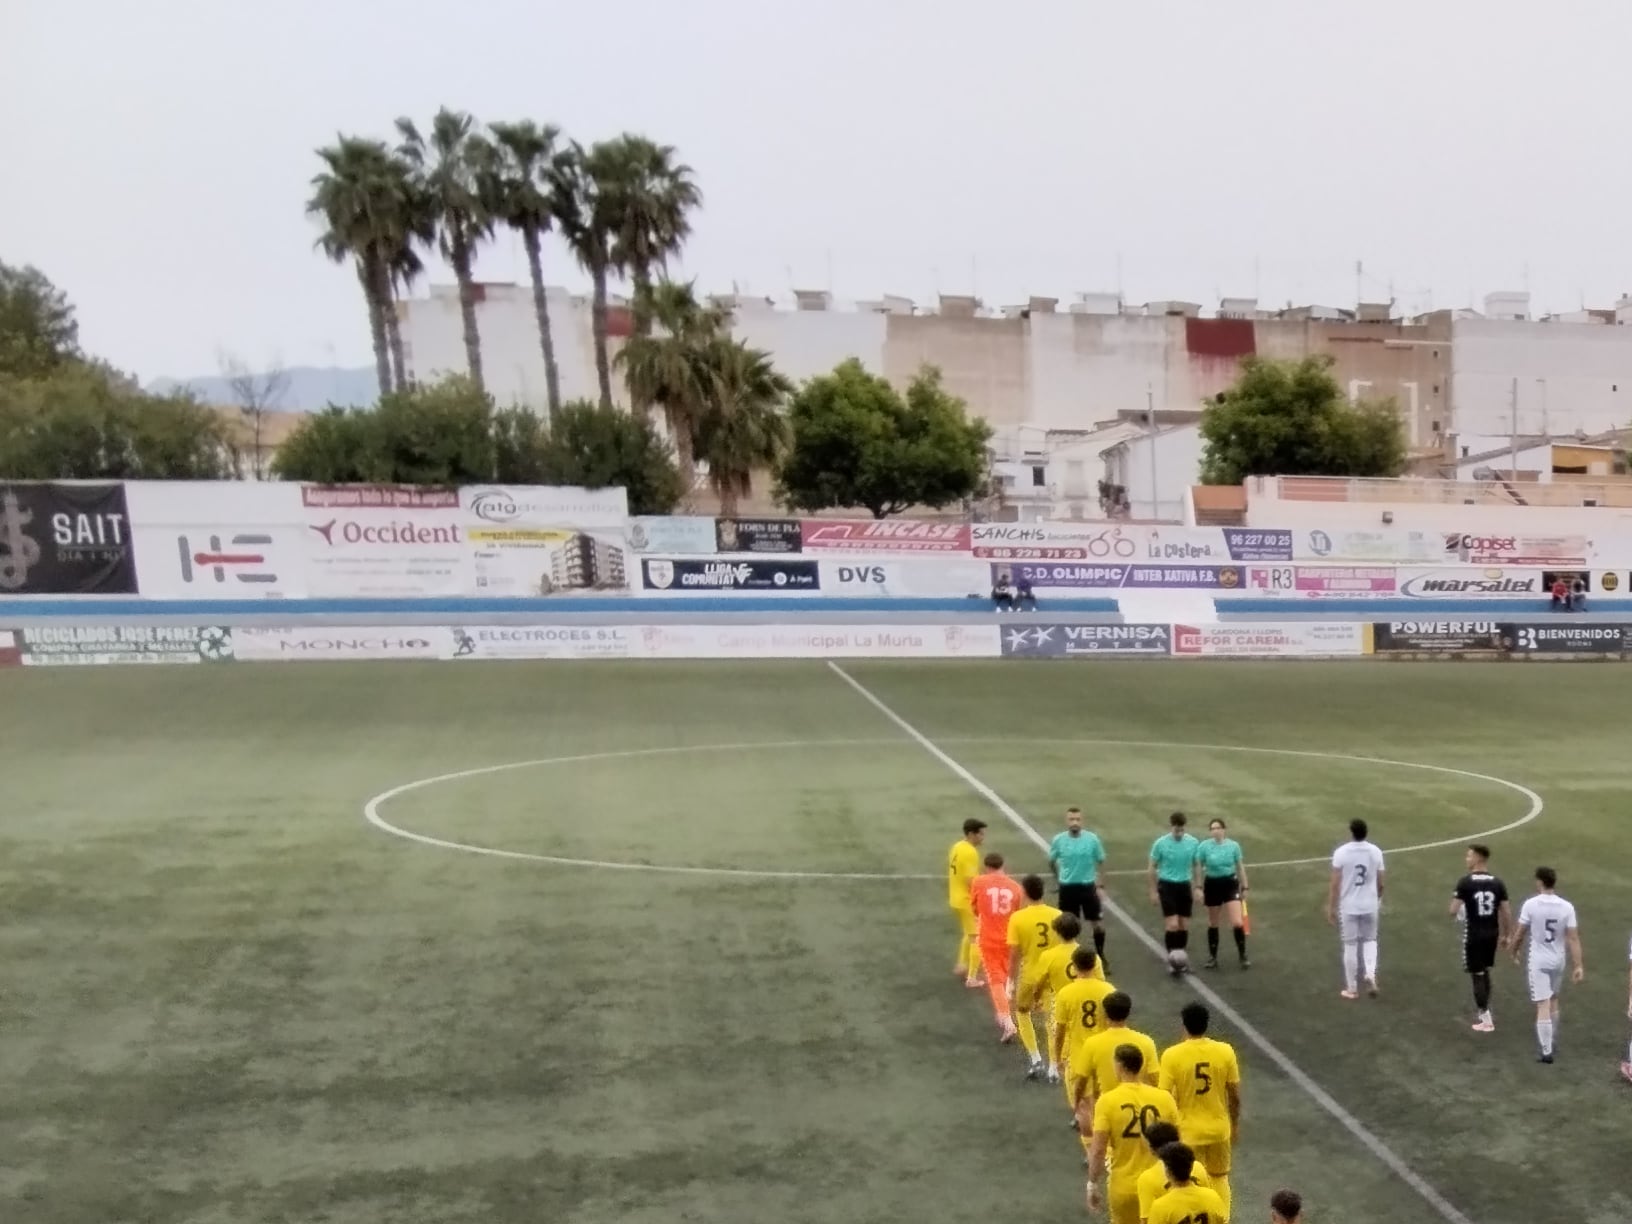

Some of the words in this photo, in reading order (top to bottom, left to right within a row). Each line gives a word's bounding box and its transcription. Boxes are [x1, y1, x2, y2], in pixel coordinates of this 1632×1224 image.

[52, 512, 123, 545] SAIT
[343, 521, 461, 544] Occident
[972, 527, 1046, 541] SANCHIS
[1231, 535, 1243, 545] 96
[1245, 535, 1263, 545] 227
[1264, 535, 1276, 545] 00
[1278, 535, 1290, 545] 25
[1462, 535, 1517, 554] Copiset
[1148, 544, 1161, 558] La
[1164, 543, 1212, 559] Costera
[838, 566, 887, 583] DVS
[1053, 567, 1122, 580] OLIMPIC
[1133, 569, 1163, 582] INTER
[1272, 569, 1293, 590] R3
[1064, 626, 1168, 639] VERNISA
[1389, 621, 1502, 634] POWERFUL
[1537, 629, 1621, 640] BIENVENIDOS
[717, 634, 767, 650] Camp
[770, 633, 848, 648] Municipal
[853, 634, 872, 647] La
[877, 633, 923, 648] Murta
[1066, 642, 1166, 650] HOTEL
[1184, 635, 1235, 646] REFOR
[1236, 636, 1290, 646] CAREMI
[1354, 864, 1368, 887] 3
[986, 886, 1014, 915] 13
[1473, 890, 1496, 917] 13
[1035, 922, 1050, 948] 3
[1544, 919, 1558, 944] 5
[1081, 999, 1098, 1029] 8
[1194, 1061, 1213, 1096] 5
[1120, 1102, 1161, 1139] 20
